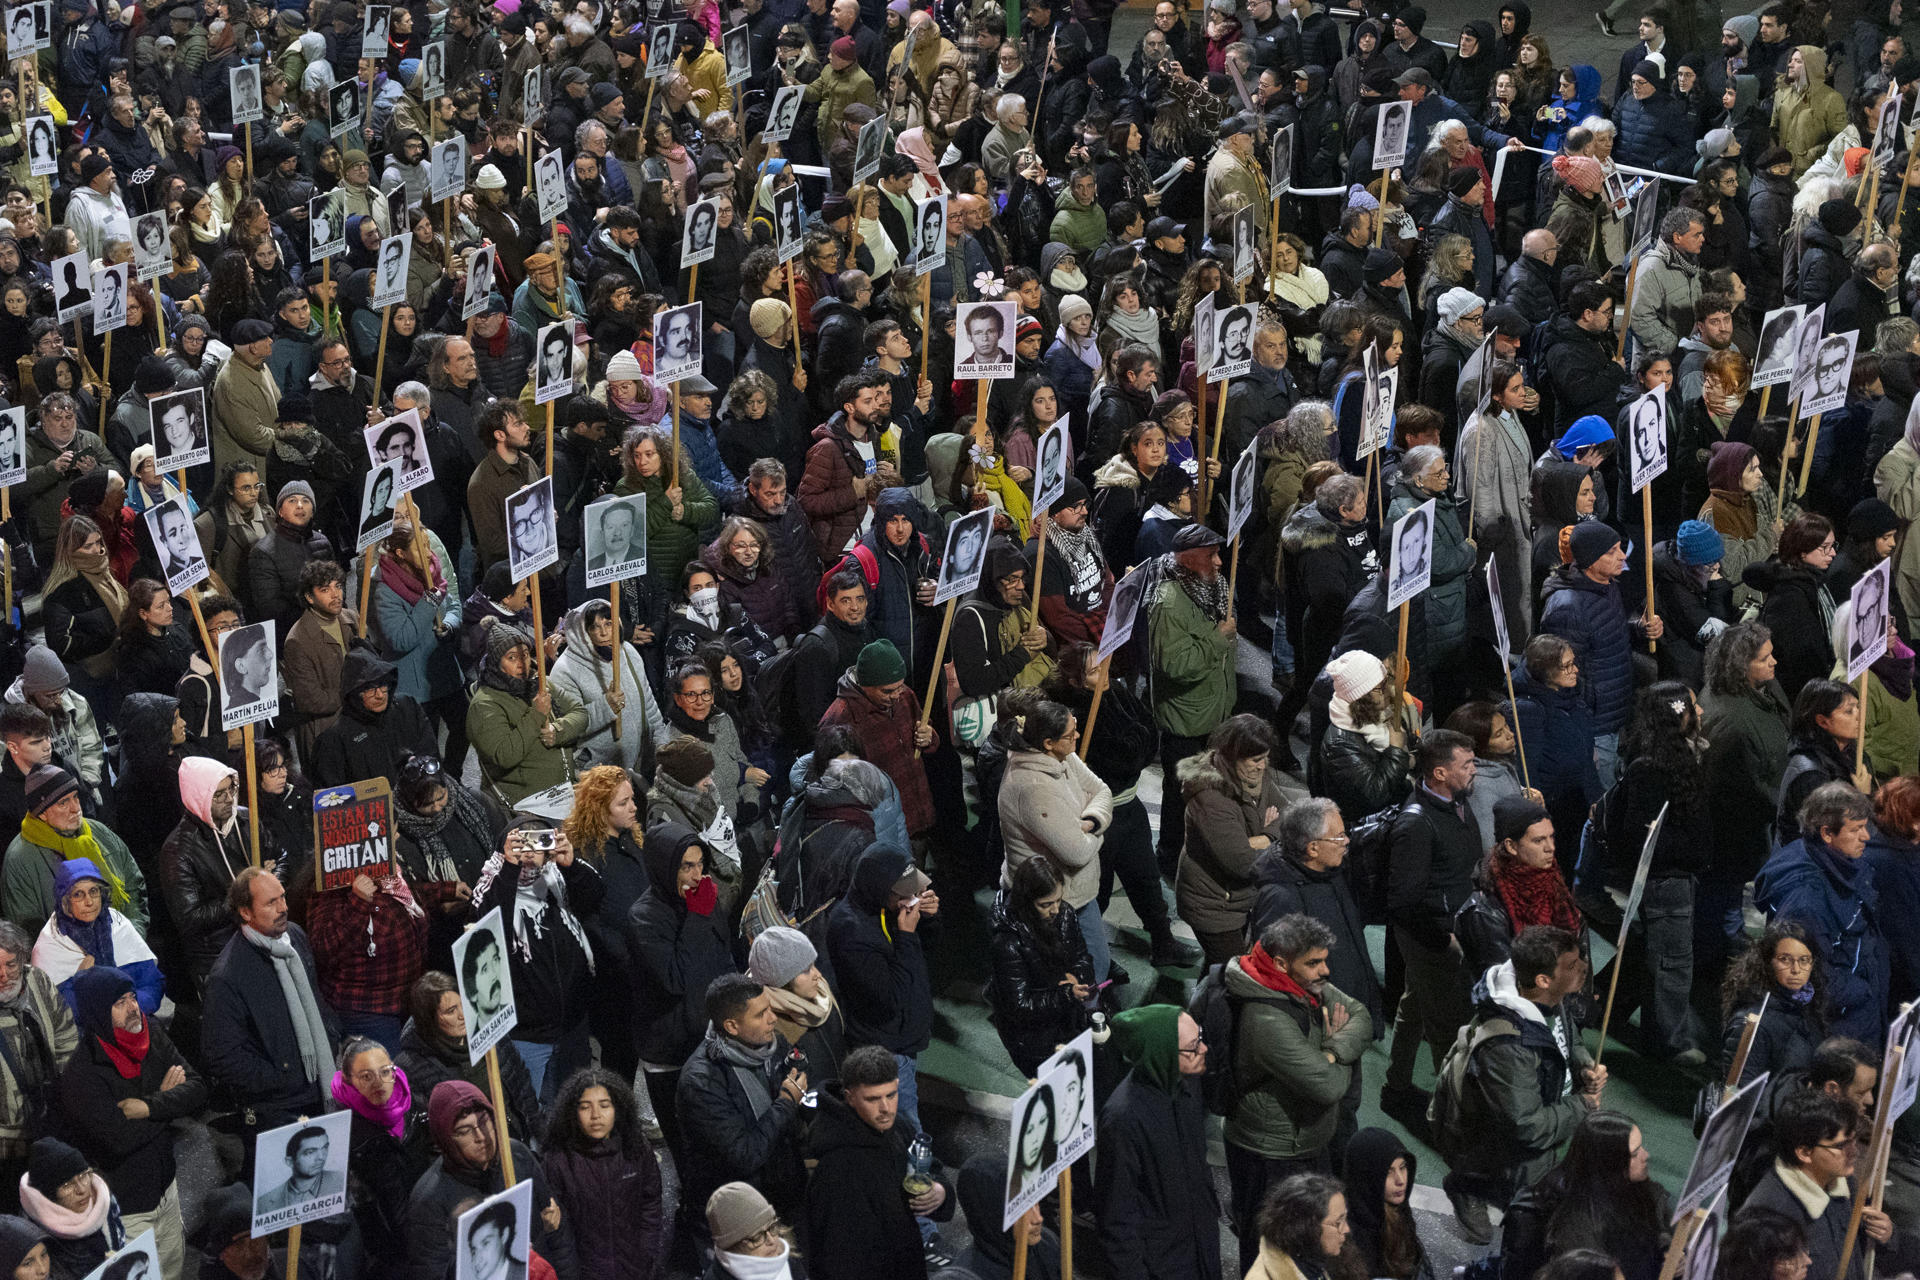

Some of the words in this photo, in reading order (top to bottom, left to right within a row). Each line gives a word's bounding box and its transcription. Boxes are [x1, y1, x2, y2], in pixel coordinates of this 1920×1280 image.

[656, 369, 676, 380] MIGUEL
[684, 361, 700, 372] MATO
[957, 365, 977, 374] RAUL
[980, 363, 1012, 374] BARRETO
[1208, 366, 1232, 377] ALFREDO
[1233, 361, 1251, 372] BOSCO
[1770, 368, 1793, 379] PEREIRA
[1826, 393, 1845, 404] SILVA
[1358, 440, 1371, 452] ABEL
[1372, 432, 1388, 448] AALA
[171, 453, 194, 465] GILBERTO
[1646, 456, 1667, 476] TRINIDAD
[406, 467, 429, 481] ALFARO
[170, 570, 189, 588] OLIVAR
[190, 562, 206, 577] SENA
[514, 562, 525, 576] JUAN
[526, 558, 537, 570] PABLO
[588, 566, 615, 579] CARLOS
[967, 574, 979, 585] LEMA
[1849, 651, 1868, 672] MANUEL
[223, 704, 252, 722] MARTÍN
[254, 698, 277, 715] PELÚA
[322, 804, 366, 832] ESTAN
[369, 800, 385, 820] EN
[324, 837, 389, 873] GRITAN
[471, 1026, 490, 1051] NELSON
[490, 1005, 514, 1032] SANTANA
[1007, 1184, 1036, 1216] ADRIANA
[1037, 1164, 1058, 1188] GATTI
[254, 1208, 299, 1229] MANUEL
[302, 1196, 343, 1213] GARCÍA
